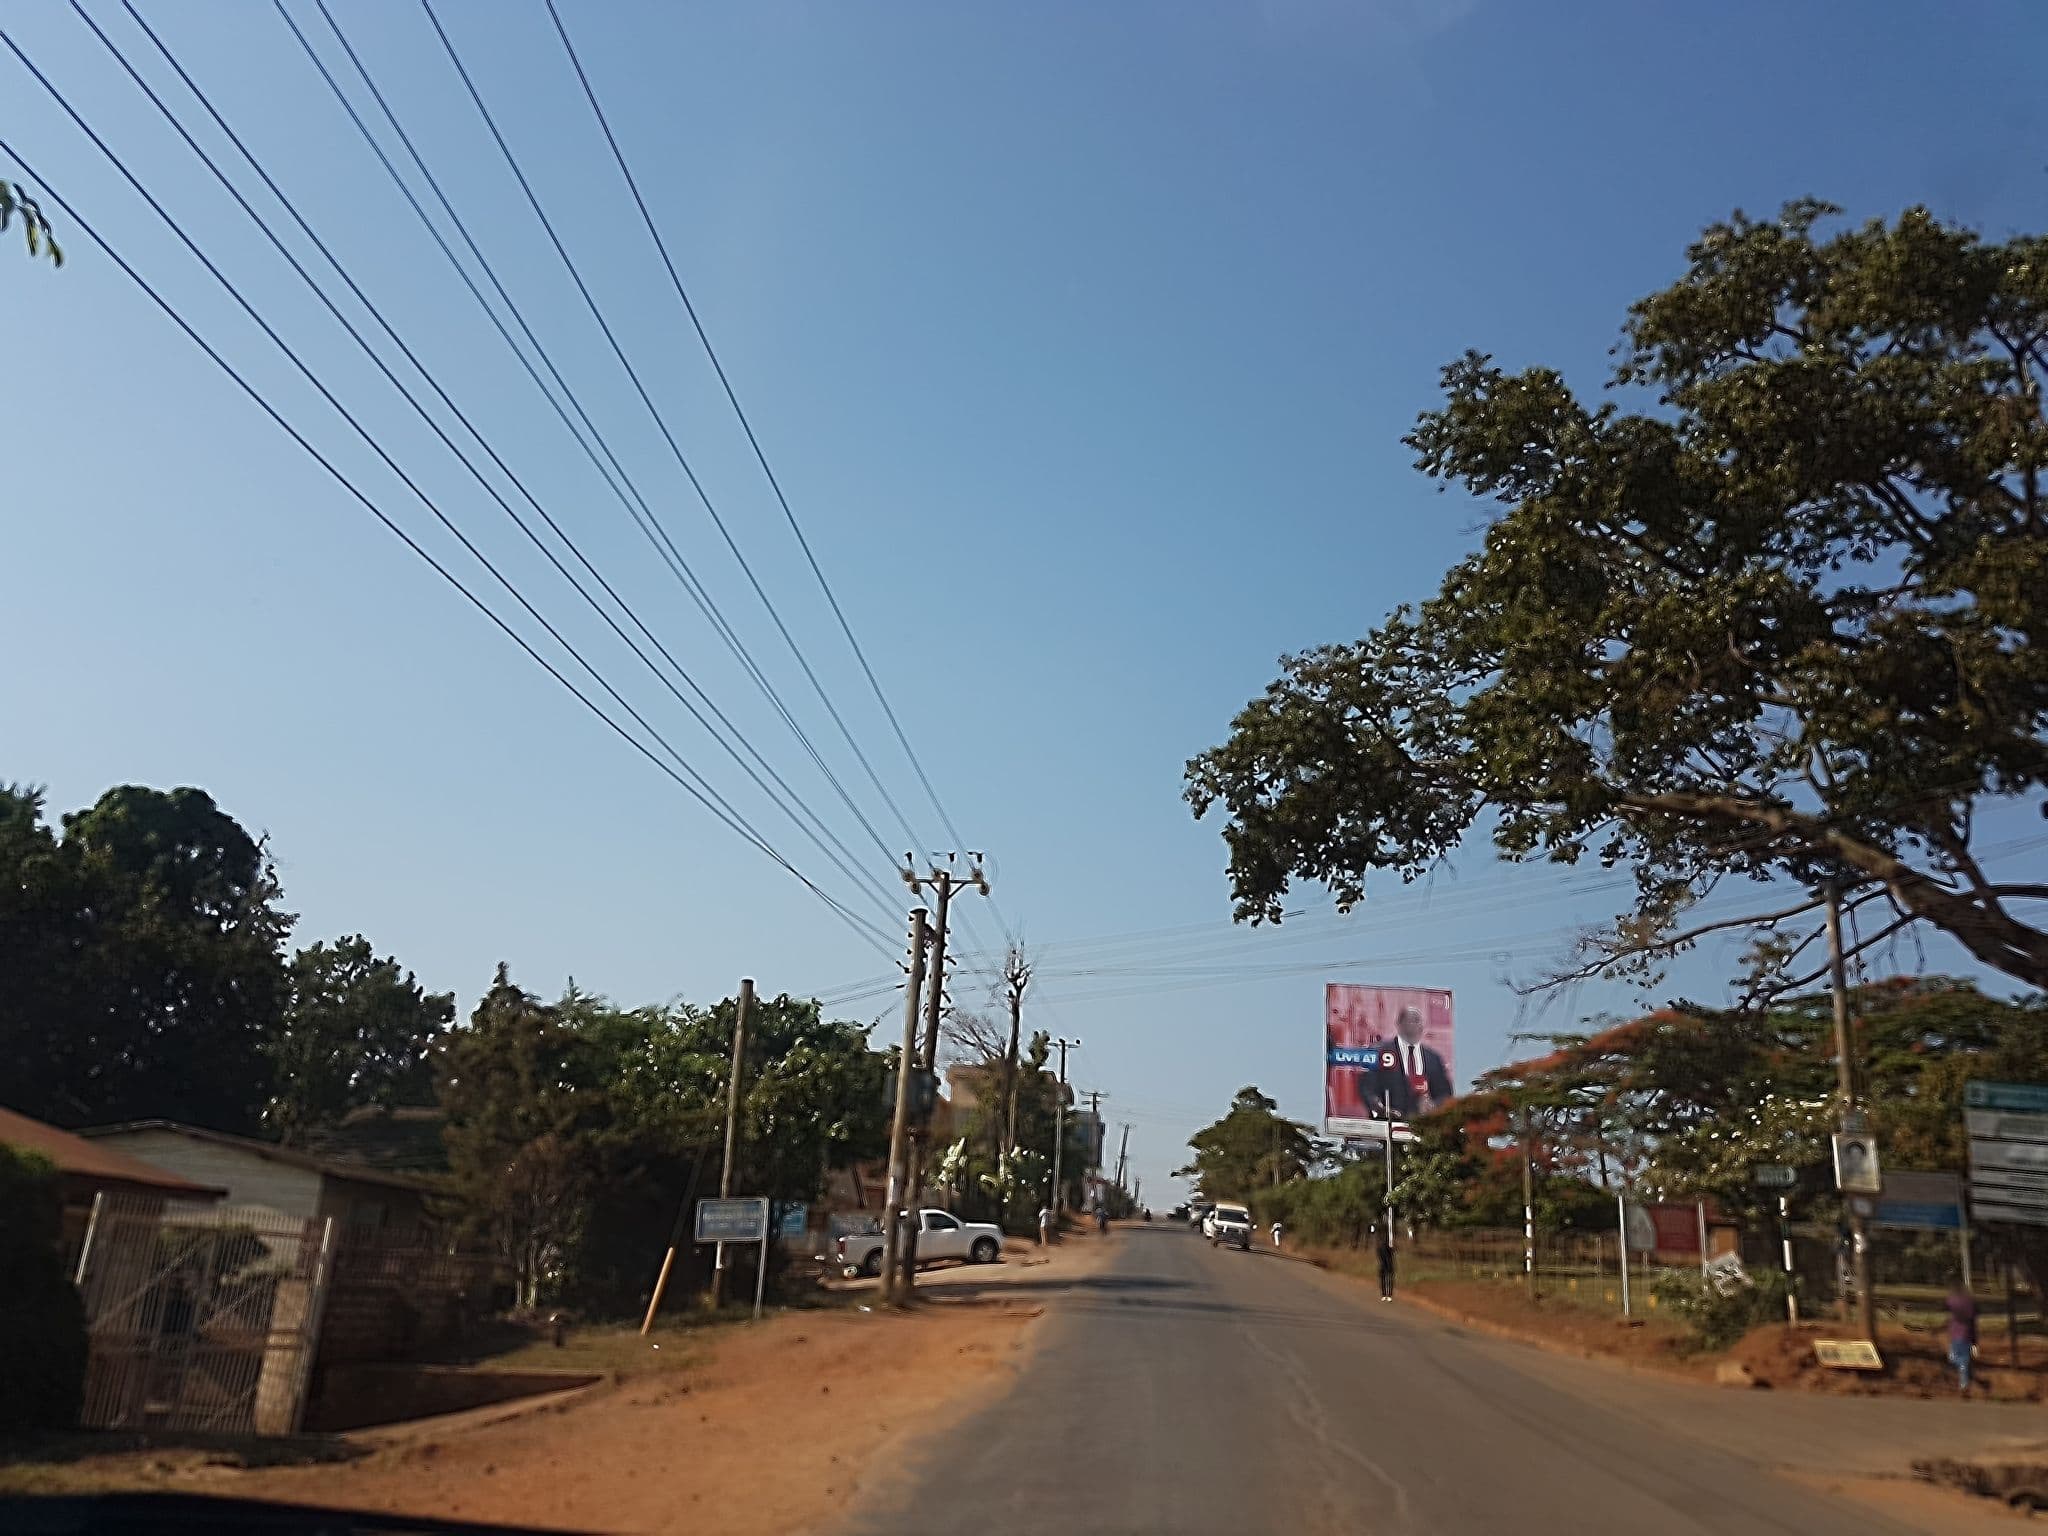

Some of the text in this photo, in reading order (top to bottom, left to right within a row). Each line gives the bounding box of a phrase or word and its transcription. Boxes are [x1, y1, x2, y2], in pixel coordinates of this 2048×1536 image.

[1335, 1052, 1395, 1067] LIVE AT 9
